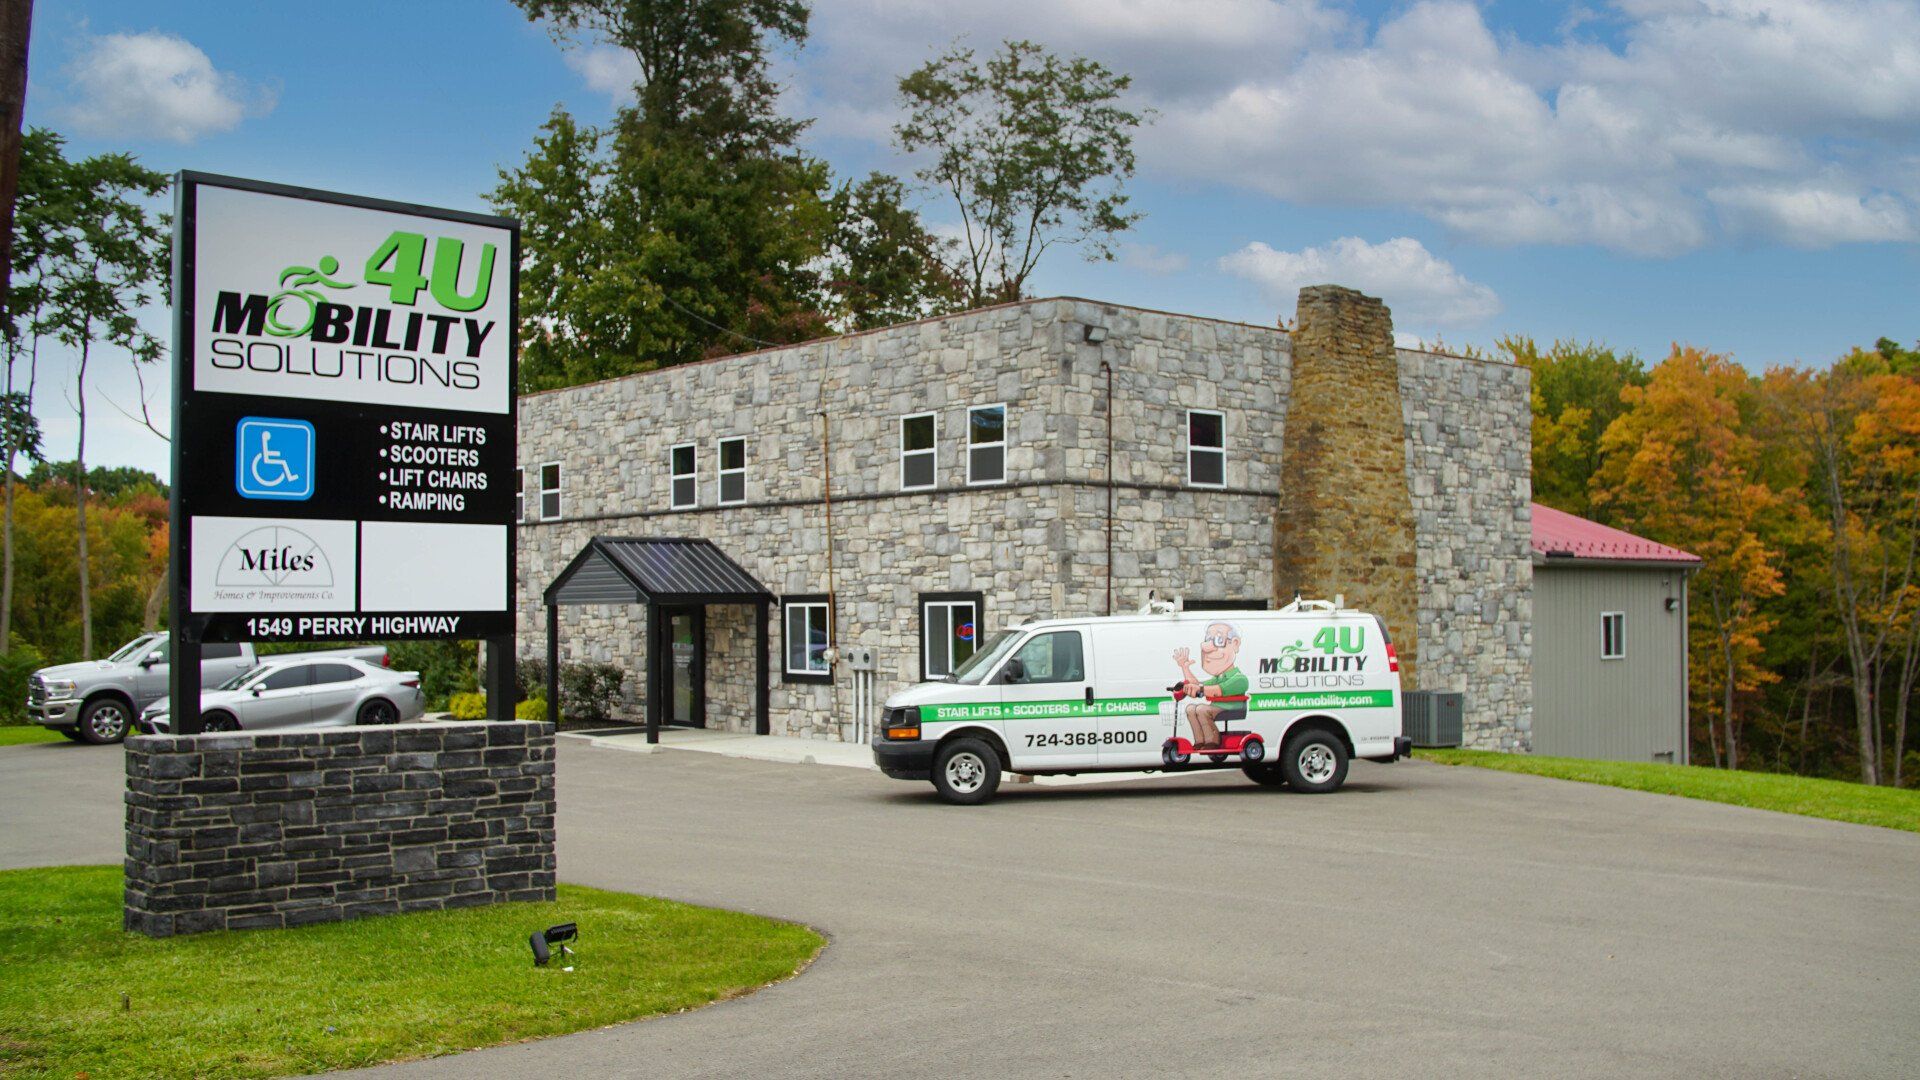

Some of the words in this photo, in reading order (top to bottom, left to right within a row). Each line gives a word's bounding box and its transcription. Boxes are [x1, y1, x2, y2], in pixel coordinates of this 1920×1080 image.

[364, 230, 497, 312] 4U
[211, 290, 496, 358] MOBILITY
[211, 338, 480, 389] SOLUTIONS
[390, 421, 439, 442] STAIR
[443, 425, 486, 445] LIFTS
[390, 444, 479, 467] SCOOTERS
[389, 468, 424, 486] LIFT
[427, 470, 488, 489] CHAIRS
[390, 491, 465, 511] RAMPING
[238, 545, 315, 571] Miles
[213, 589, 244, 600] Homes
[246, 591, 256, 600] &
[258, 589, 320, 603] Improvements
[321, 591, 334, 600] Co.
[247, 619, 292, 635] 1549
[299, 617, 366, 635] PERRY
[371, 616, 460, 634] HIGHWAY
[1312, 626, 1365, 654] 4U
[1259, 654, 1368, 674] MOBILITY
[1259, 674, 1365, 689] SOLUTIONS
[937, 707, 969, 718] STAIR
[972, 706, 1001, 716] LIFTS
[1013, 703, 1070, 715] SCOOTERS
[1081, 702, 1103, 713] LIFT
[1106, 701, 1146, 712] CHAIRS
[1257, 694, 1373, 708] www.4umobility.com
[1025, 730, 1147, 747] 724-368-8000
